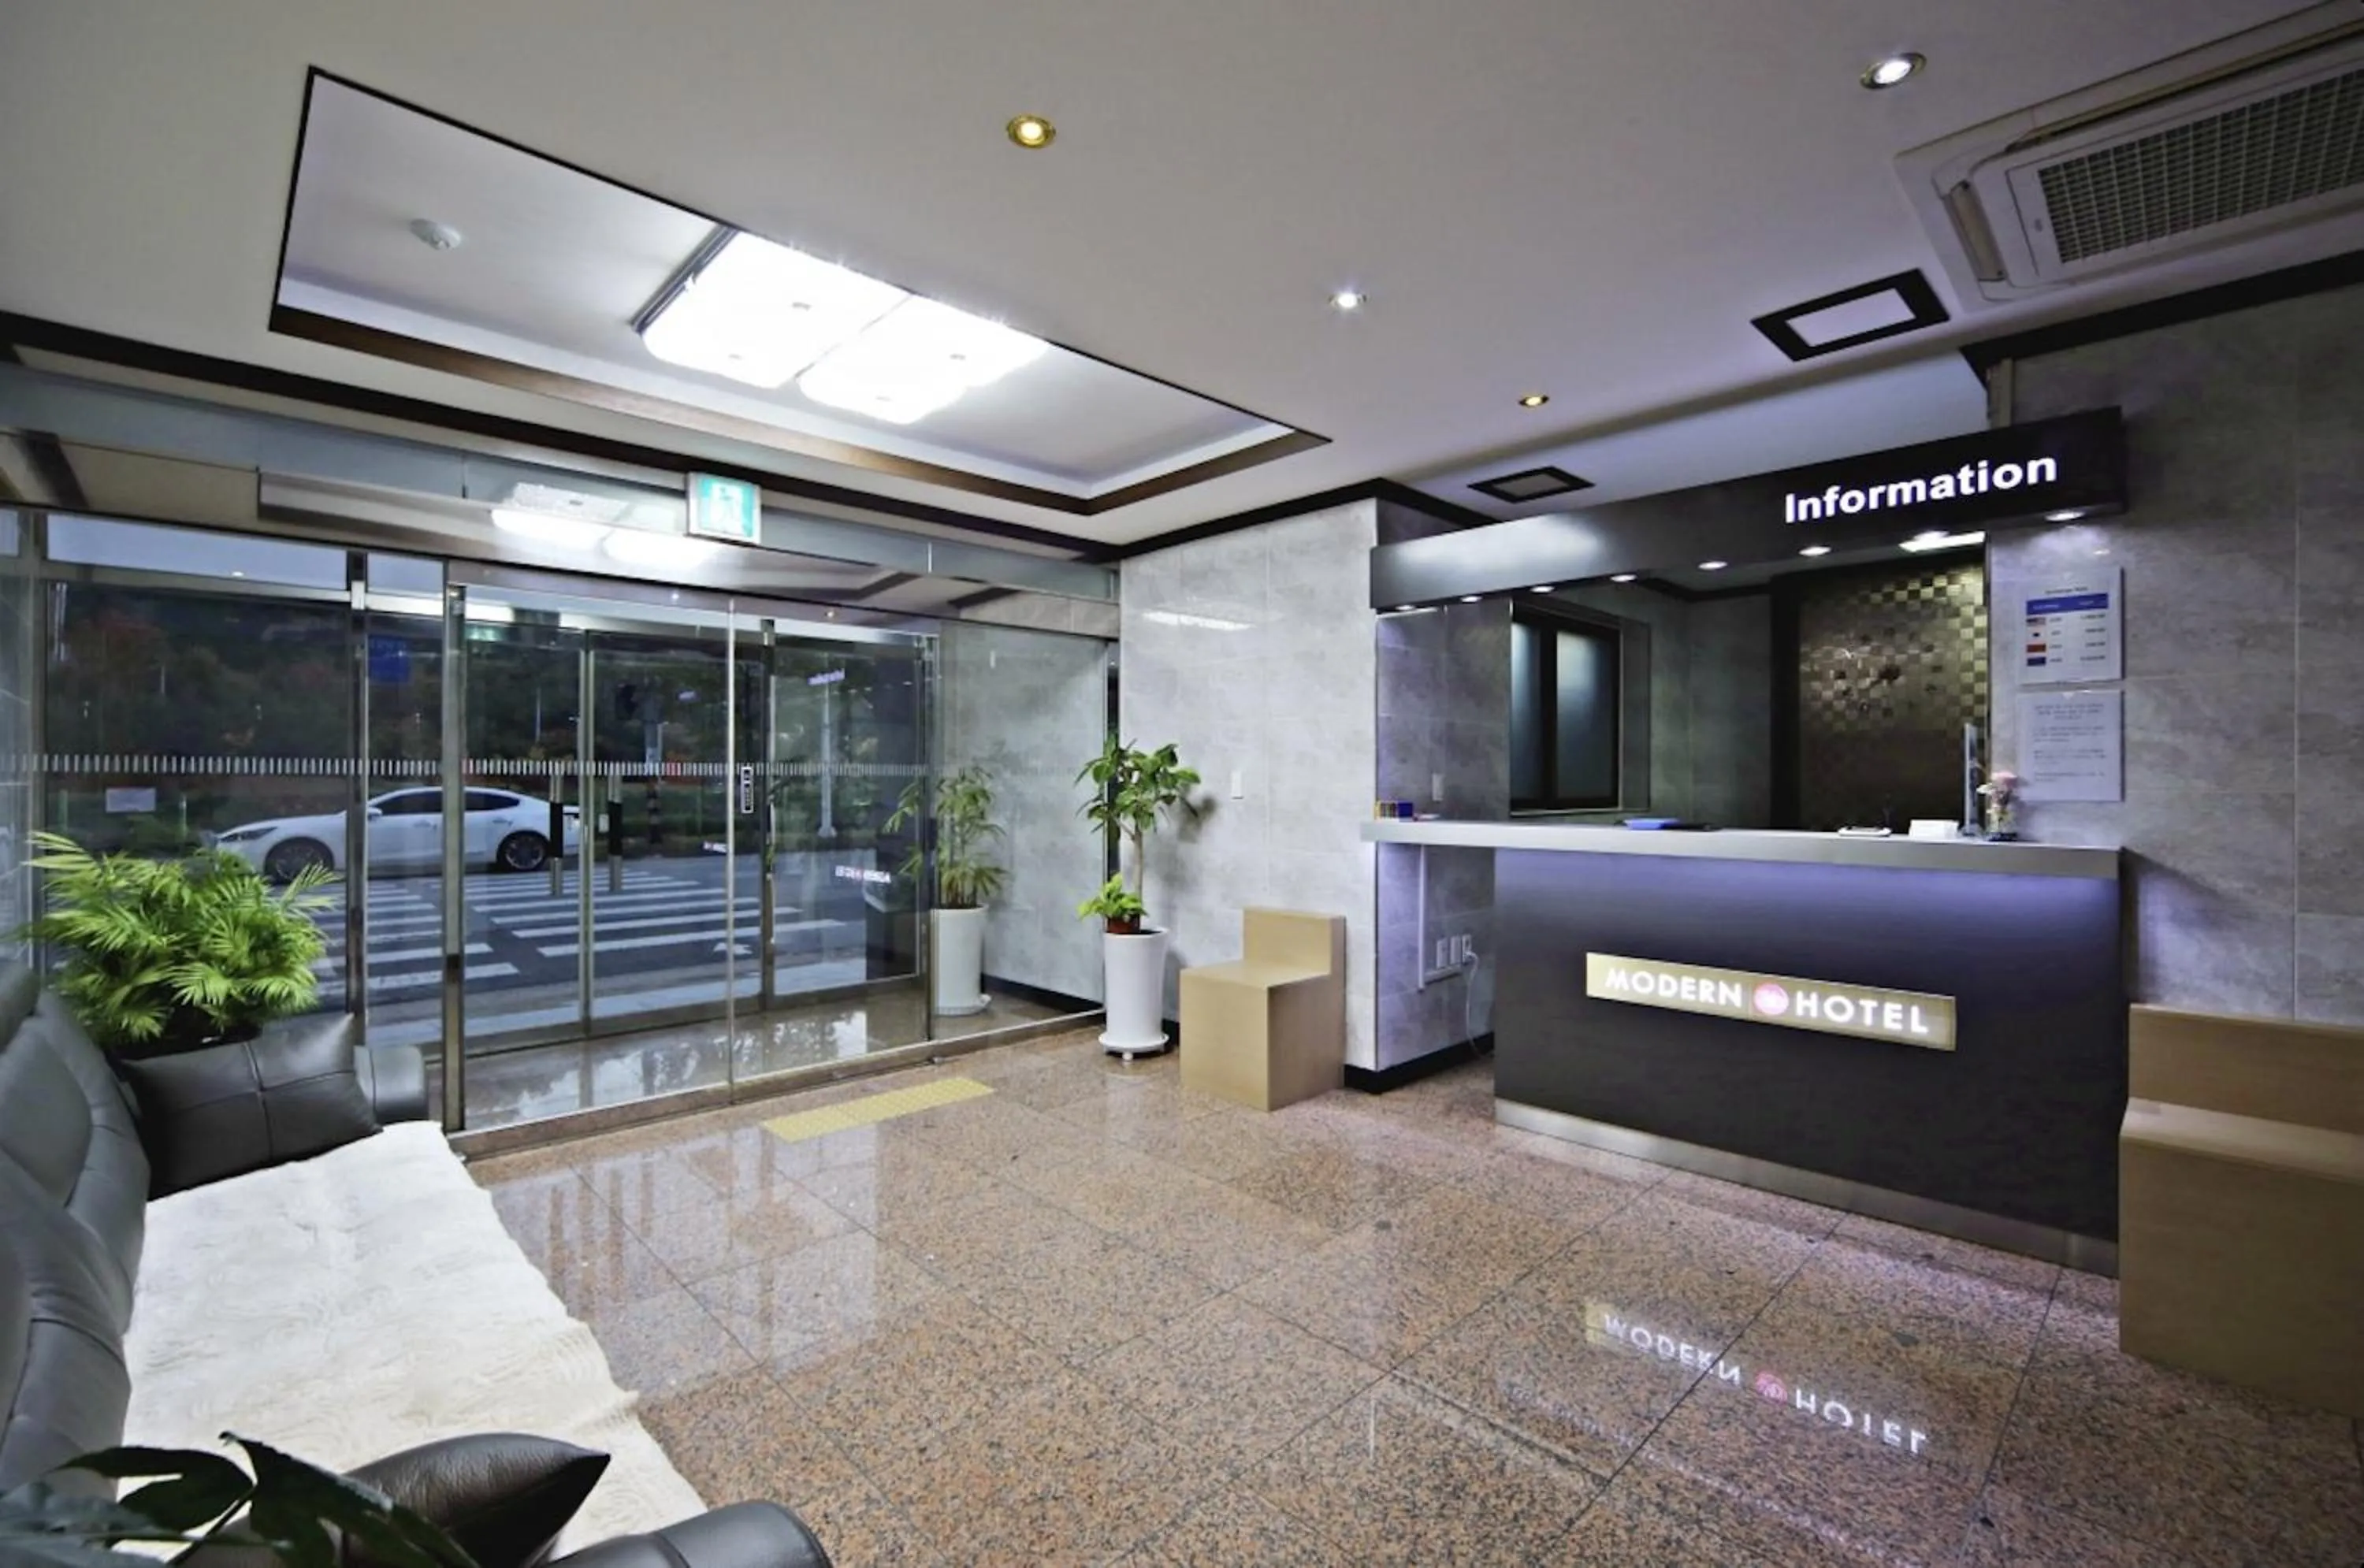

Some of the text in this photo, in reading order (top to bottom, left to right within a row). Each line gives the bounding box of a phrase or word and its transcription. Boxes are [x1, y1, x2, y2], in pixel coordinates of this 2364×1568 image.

[1785, 457, 2057, 523] Information
[1604, 968, 1929, 1034] MODERN HOTEL
